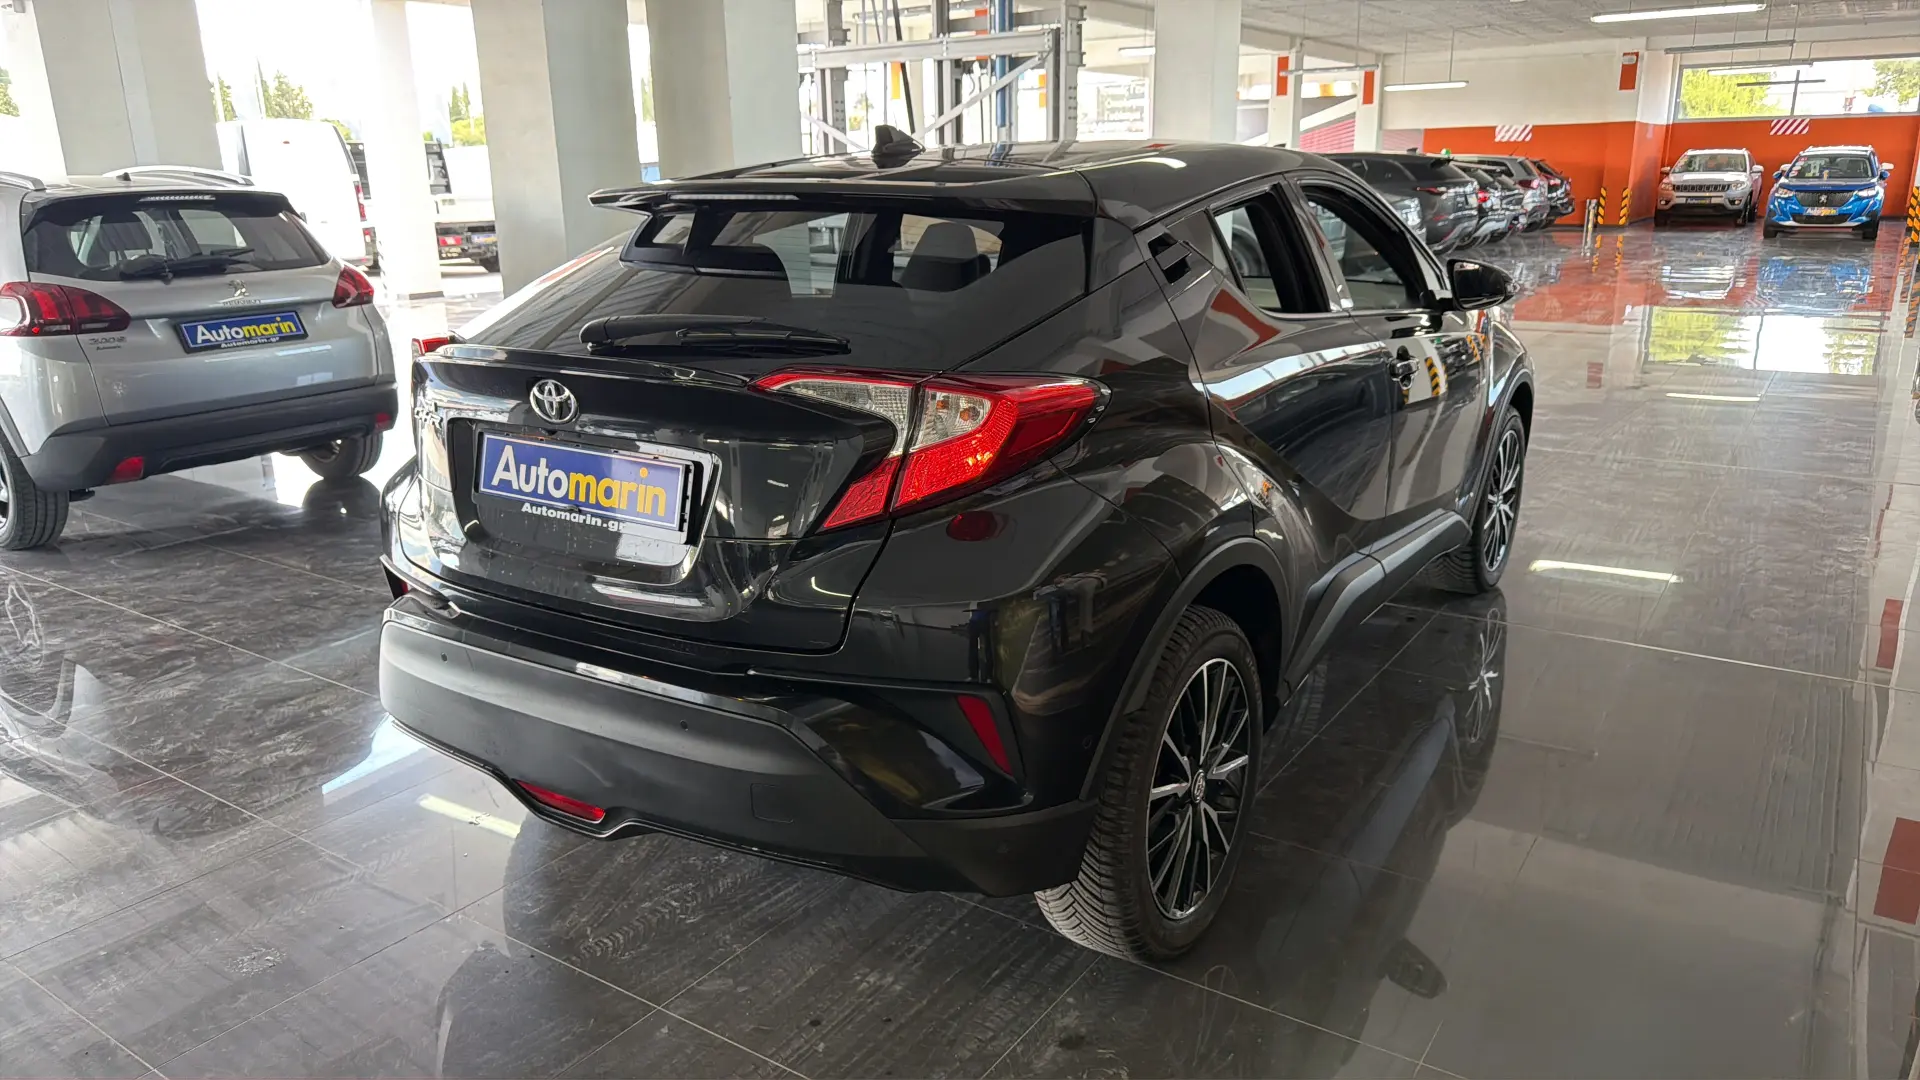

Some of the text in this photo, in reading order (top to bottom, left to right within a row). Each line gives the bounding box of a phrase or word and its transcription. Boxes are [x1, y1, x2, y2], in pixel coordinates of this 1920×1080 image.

[196, 317, 297, 344] Automarin
[220, 336, 280, 349] Automarin.gr
[491, 444, 667, 517] Automarin
[521, 502, 626, 532] Automarin.gr
